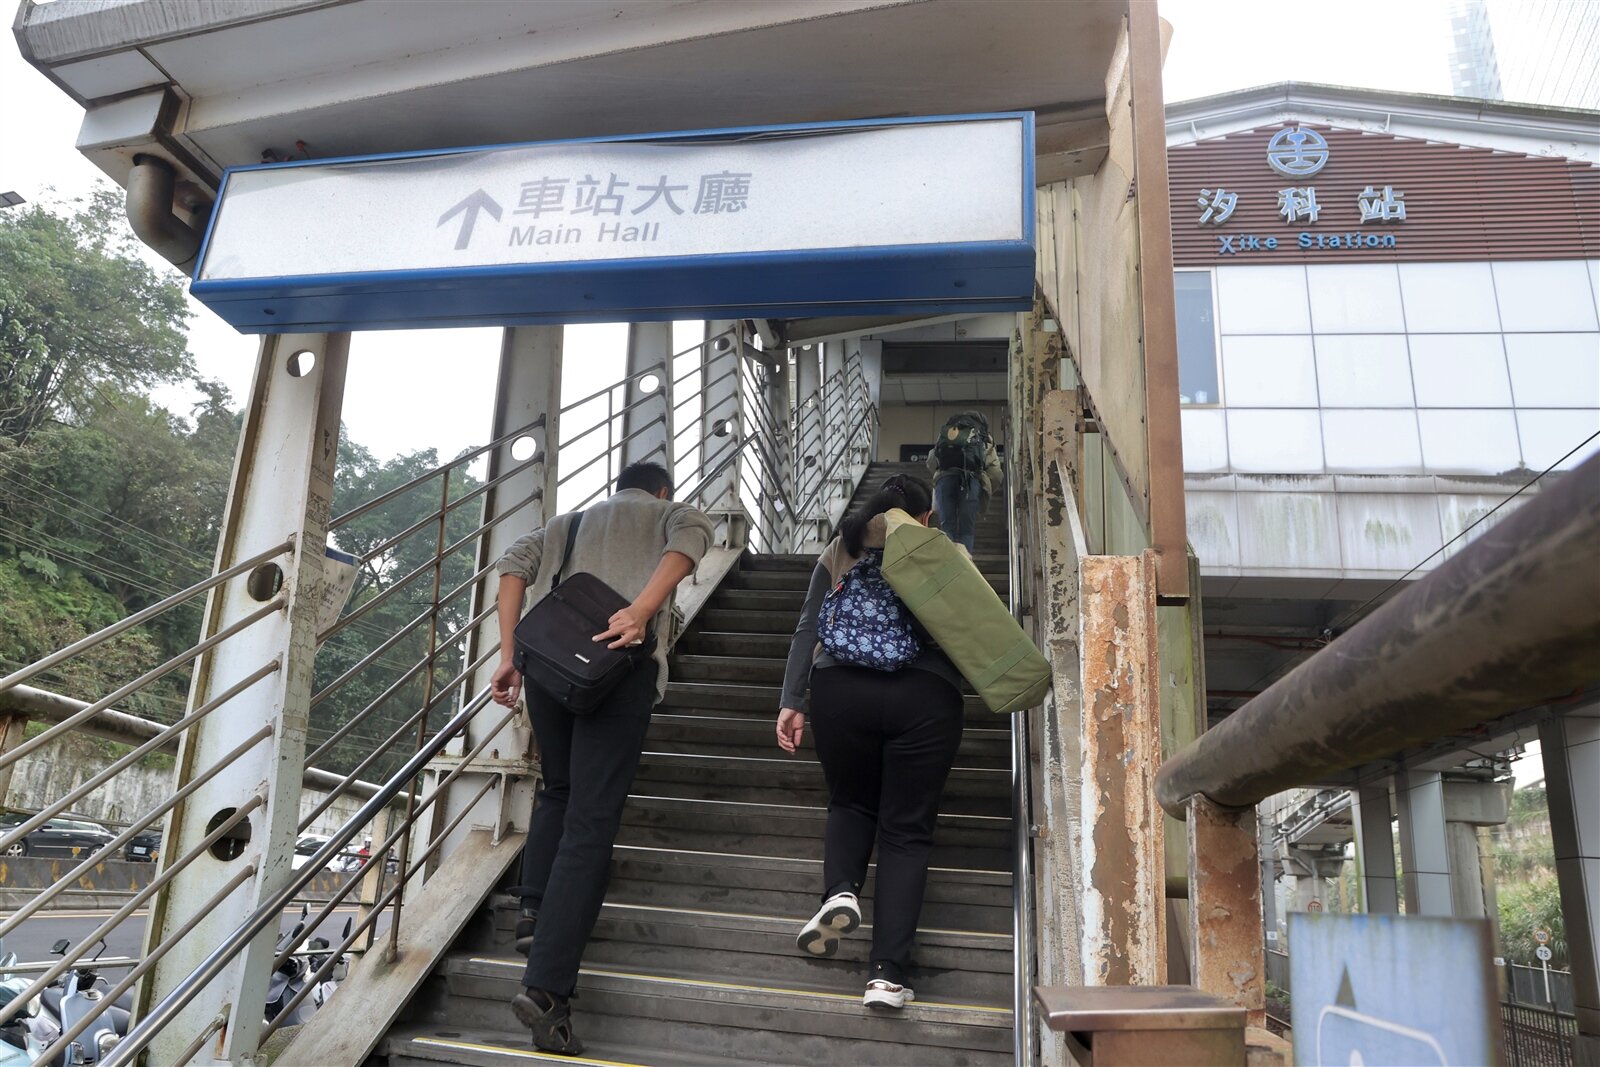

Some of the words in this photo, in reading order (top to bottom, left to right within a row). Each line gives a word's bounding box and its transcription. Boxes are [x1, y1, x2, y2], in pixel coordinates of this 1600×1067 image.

[512, 170, 752, 219] 車站大廳
[1197, 185, 1407, 227] 汐科站
[508, 223, 581, 247] Main
[598, 222, 660, 243] Hall
[1218, 234, 1279, 253] Xike
[1297, 232, 1396, 249] Station
